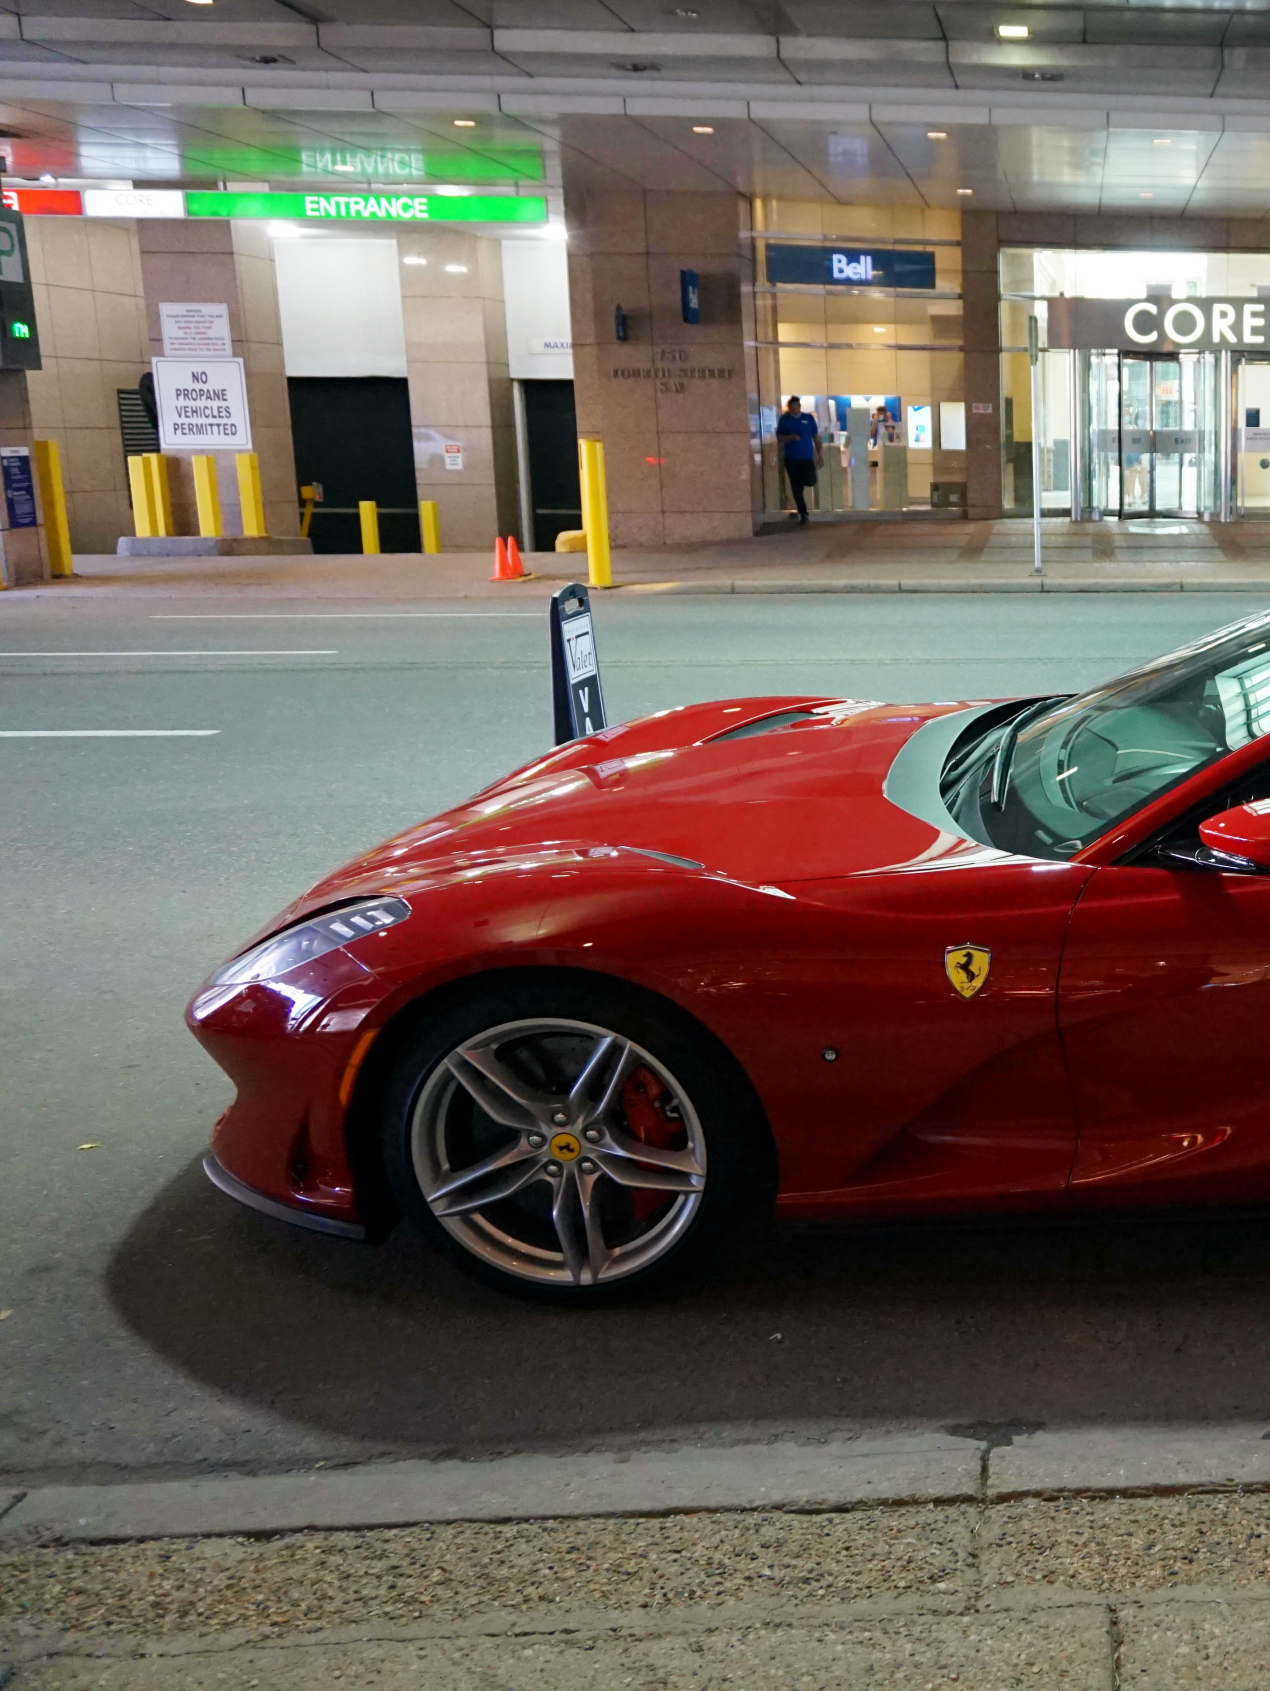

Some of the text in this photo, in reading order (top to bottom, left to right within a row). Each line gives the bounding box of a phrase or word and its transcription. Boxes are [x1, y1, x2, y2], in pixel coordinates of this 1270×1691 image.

[115, 193, 153, 206] CORE
[304, 196, 429, 218] ENTRANCE
[832, 253, 872, 280] Bell
[1124, 302, 1265, 344] CORE
[191, 371, 208, 384] NO
[175, 388, 229, 402] PROPANE
[175, 405, 232, 419] VEHICLES
[173, 422, 238, 436] PERMITTED
[566, 631, 592, 673] Valet
